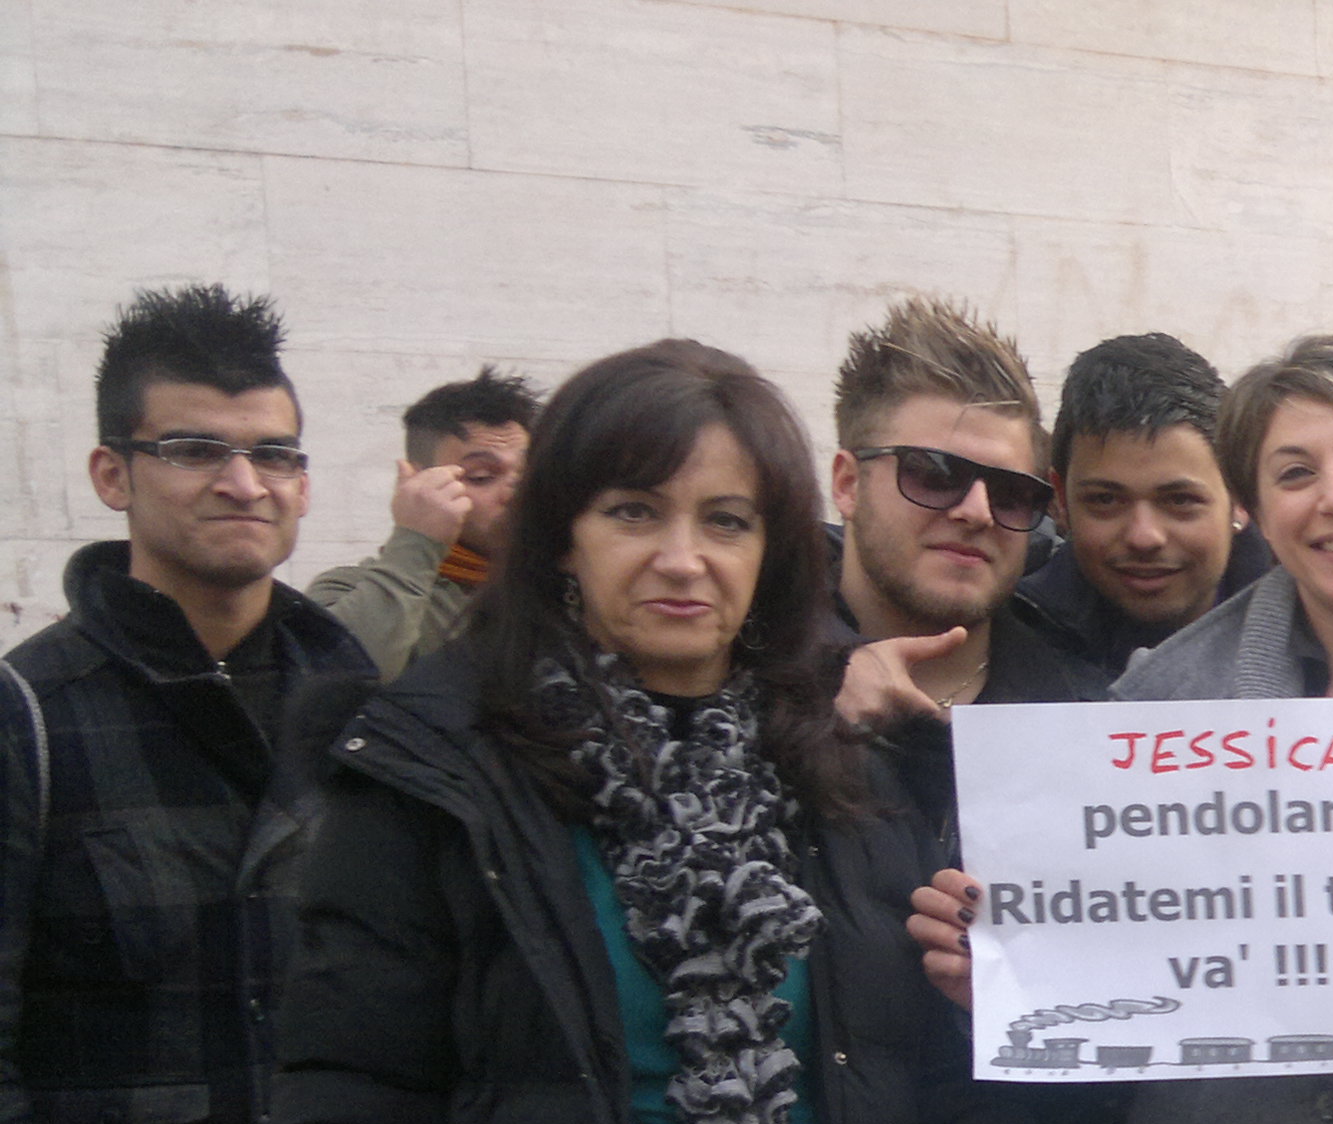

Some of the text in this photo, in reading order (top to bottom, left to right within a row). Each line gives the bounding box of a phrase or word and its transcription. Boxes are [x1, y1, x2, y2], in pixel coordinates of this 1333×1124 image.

[988, 876, 1253, 926] Ridatemi
[1274, 874, 1306, 919] il
[1167, 943, 1329, 990] va' !!!
